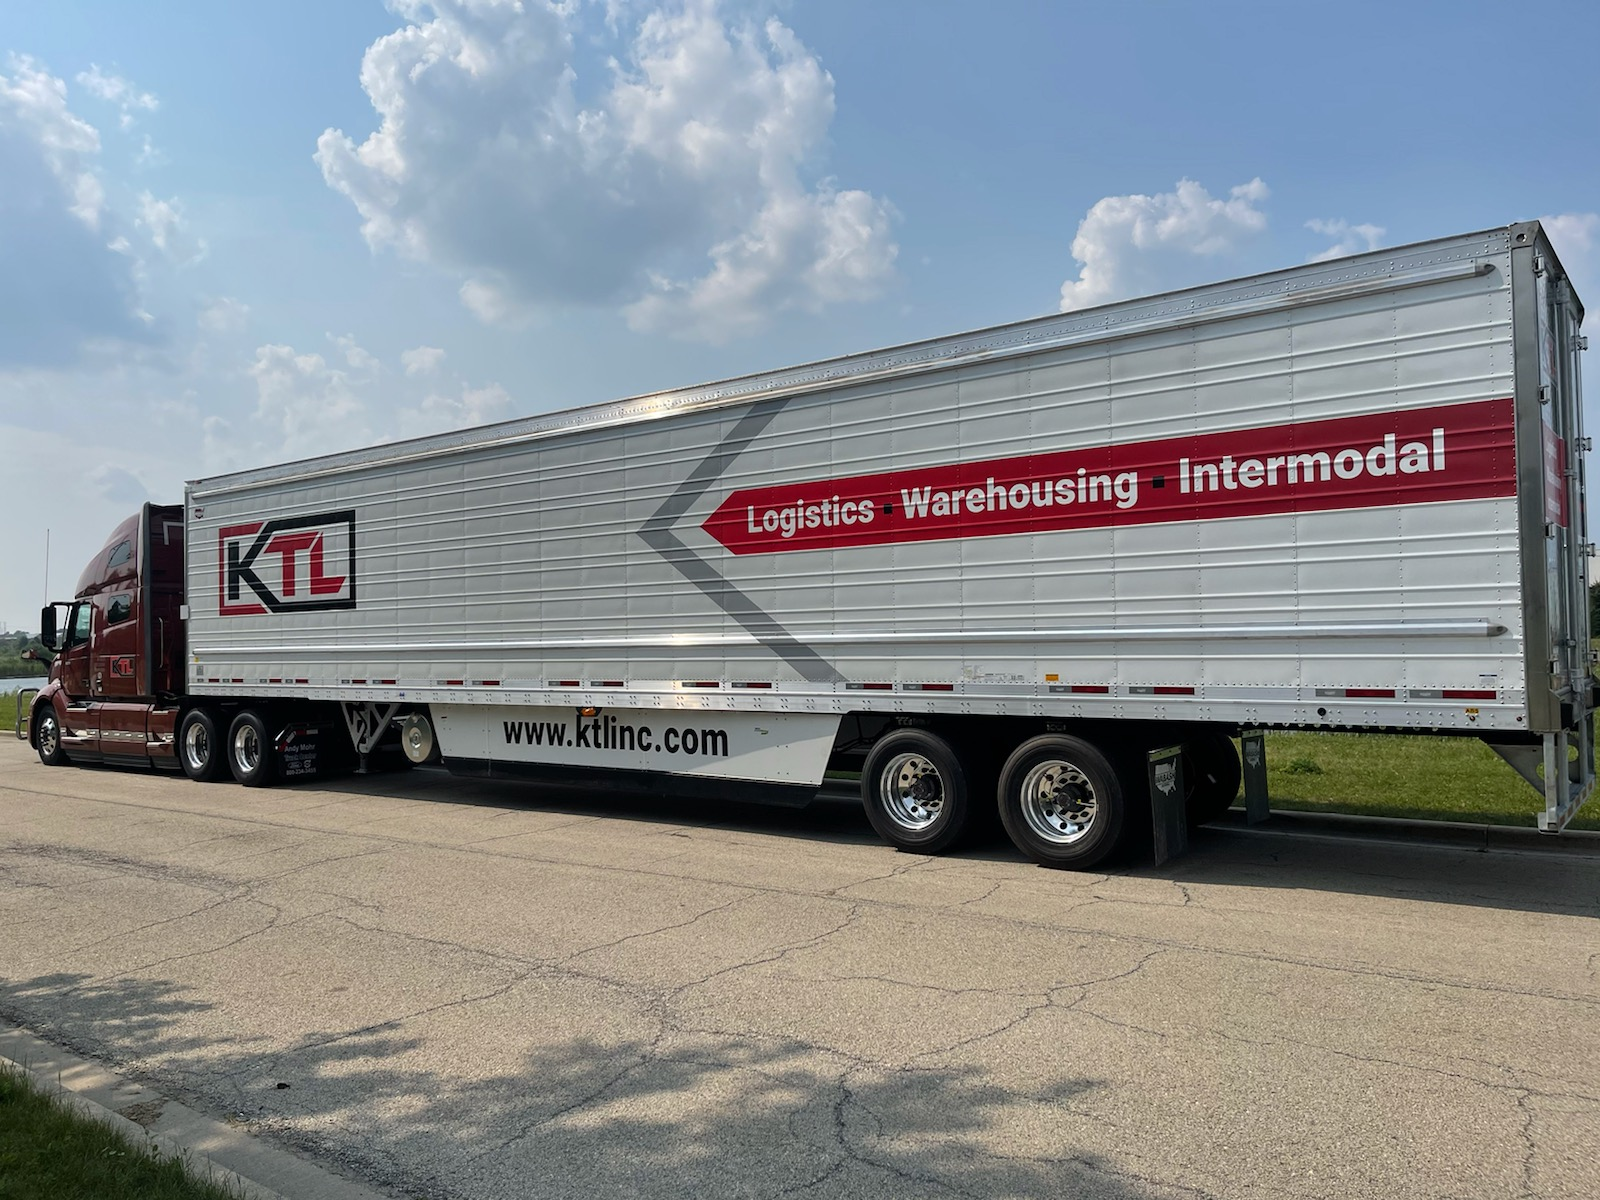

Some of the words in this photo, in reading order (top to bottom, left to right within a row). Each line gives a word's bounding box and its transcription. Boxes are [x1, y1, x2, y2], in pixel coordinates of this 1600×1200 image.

[747, 494, 875, 538] Logistics
[901, 467, 1138, 507] Warehousing
[1179, 427, 1445, 492] Intermodal
[225, 518, 350, 613] KTL
[503, 715, 729, 757] www.ktlinc.com
